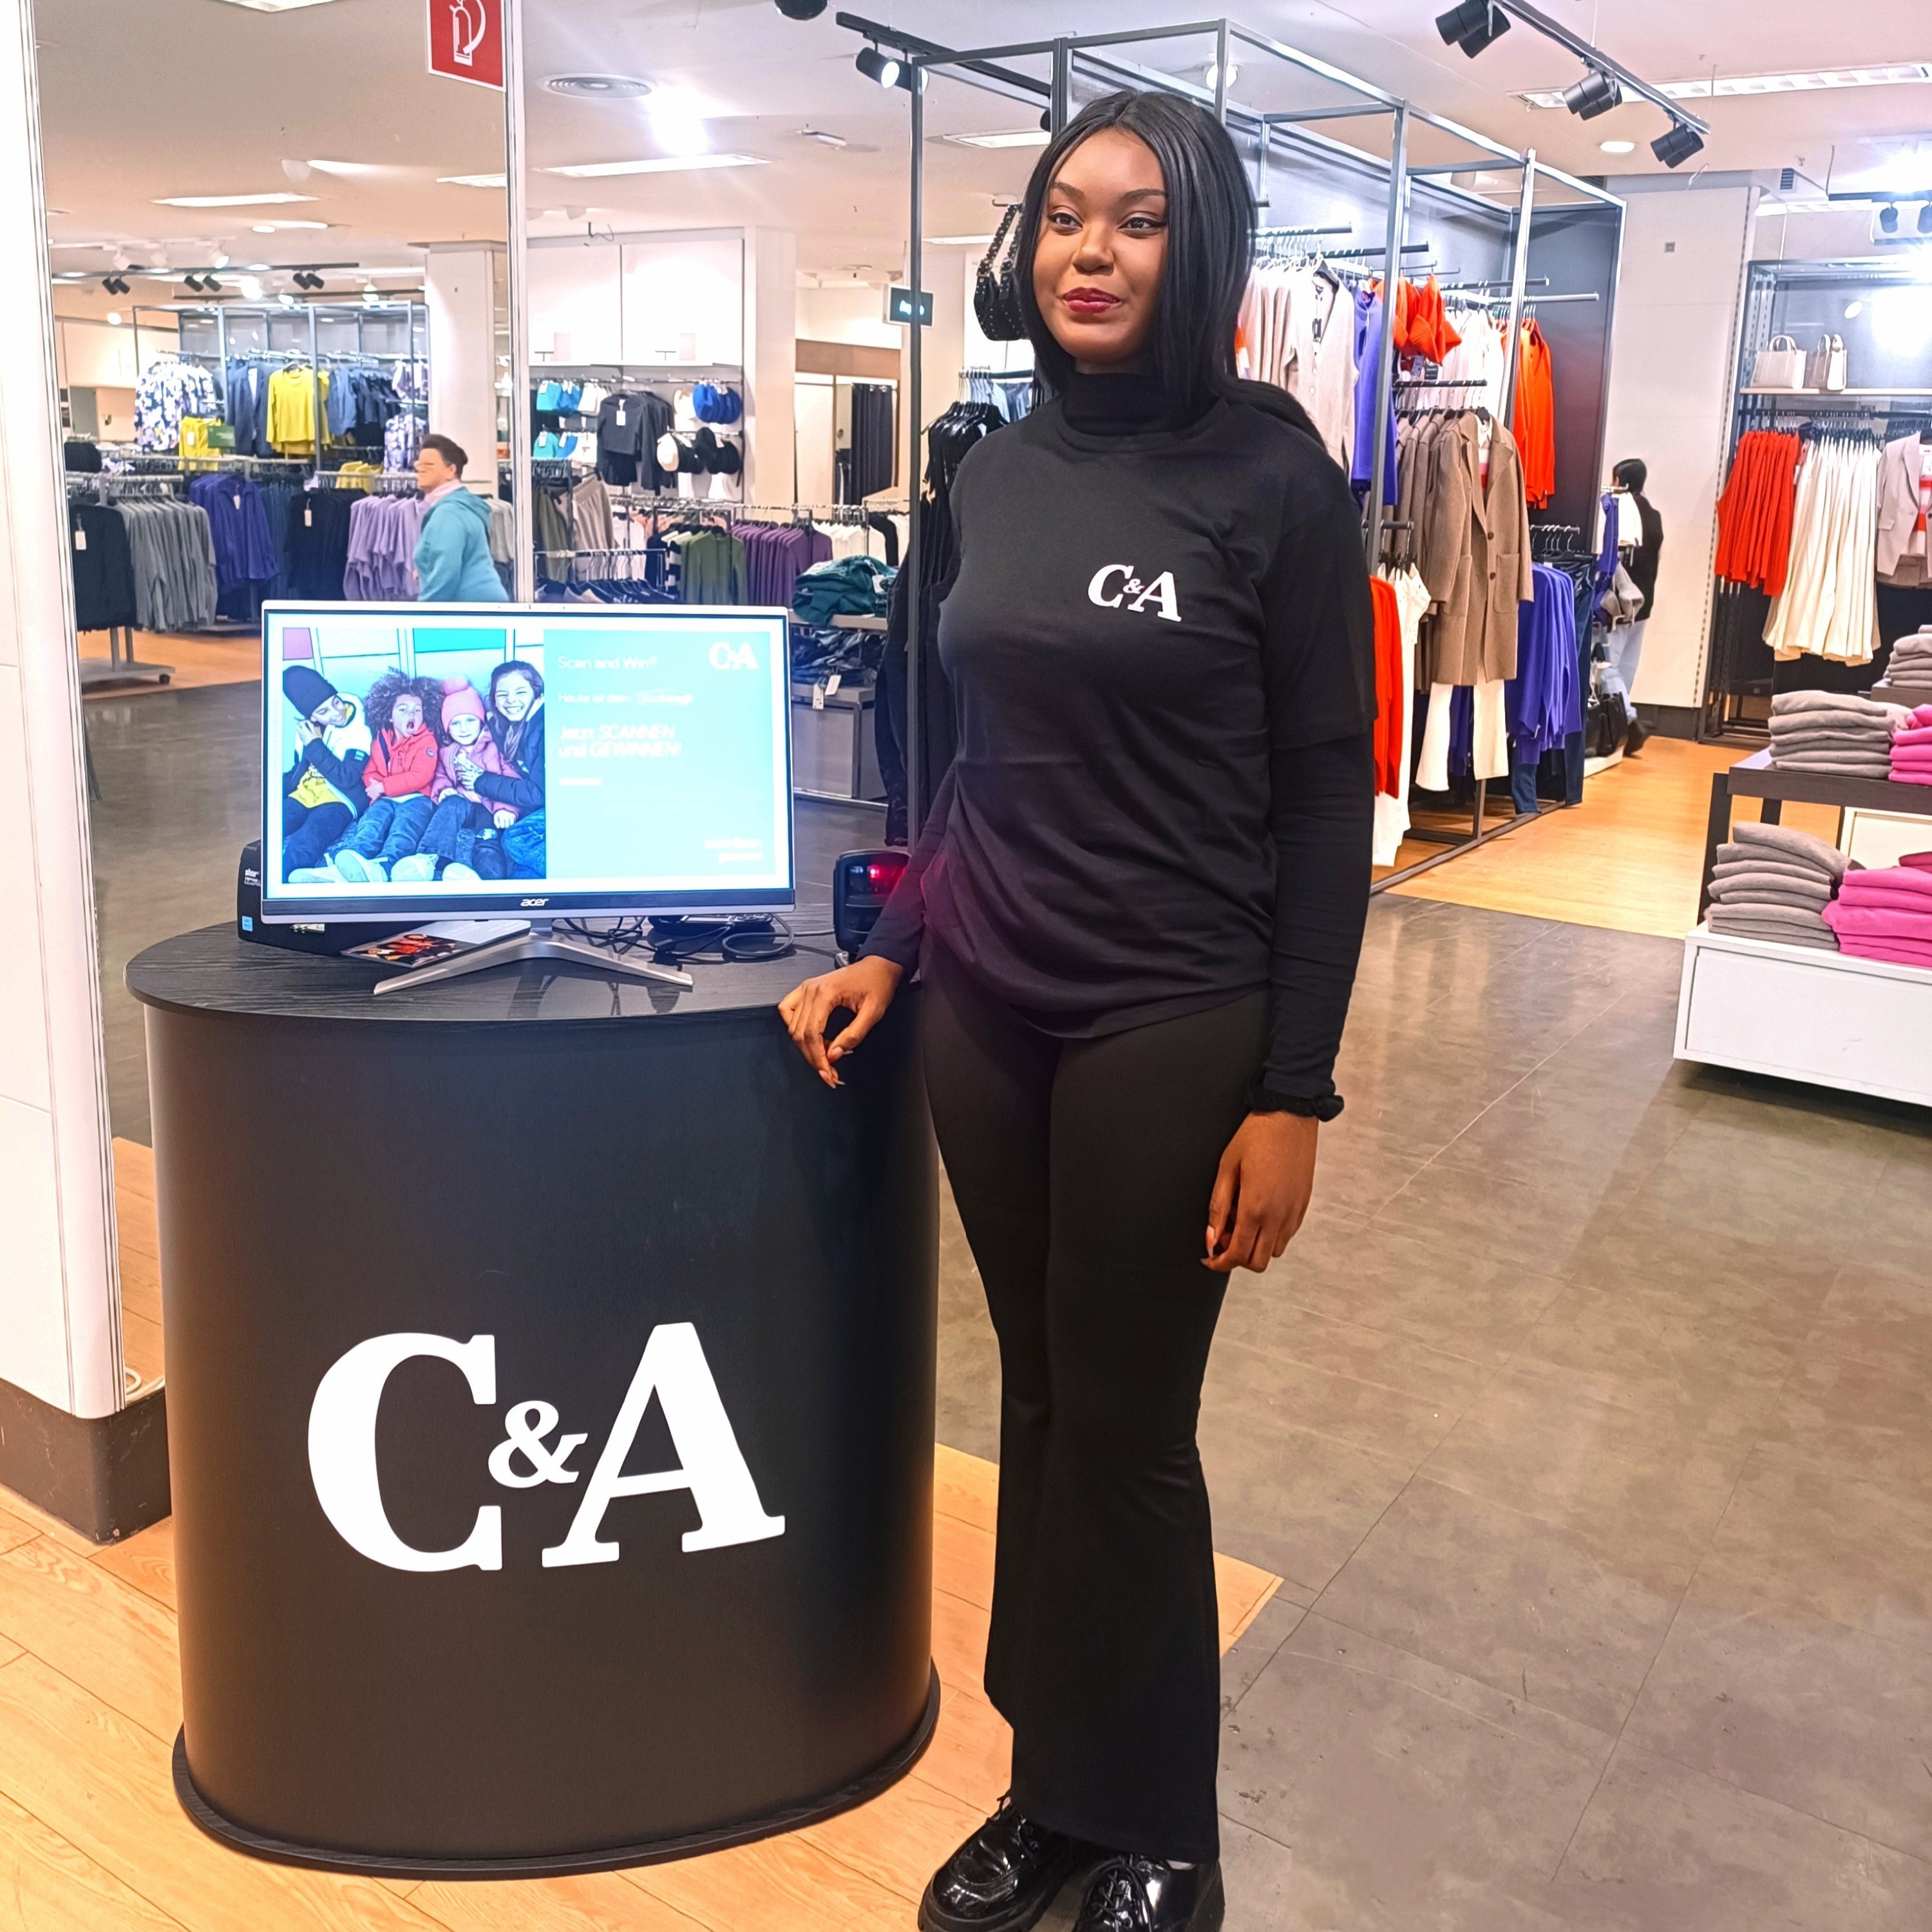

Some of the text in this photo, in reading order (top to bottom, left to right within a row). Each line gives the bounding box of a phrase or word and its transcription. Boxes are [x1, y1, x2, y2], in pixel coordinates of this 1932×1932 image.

[1088, 564, 1182, 622] C&A
[557, 656, 591, 668] Scan
[594, 656, 619, 668] and
[599, 724, 676, 739] SCANNEN
[558, 743, 587, 757] und
[520, 898, 549, 907] acer
[308, 1321, 786, 1573] C&A
